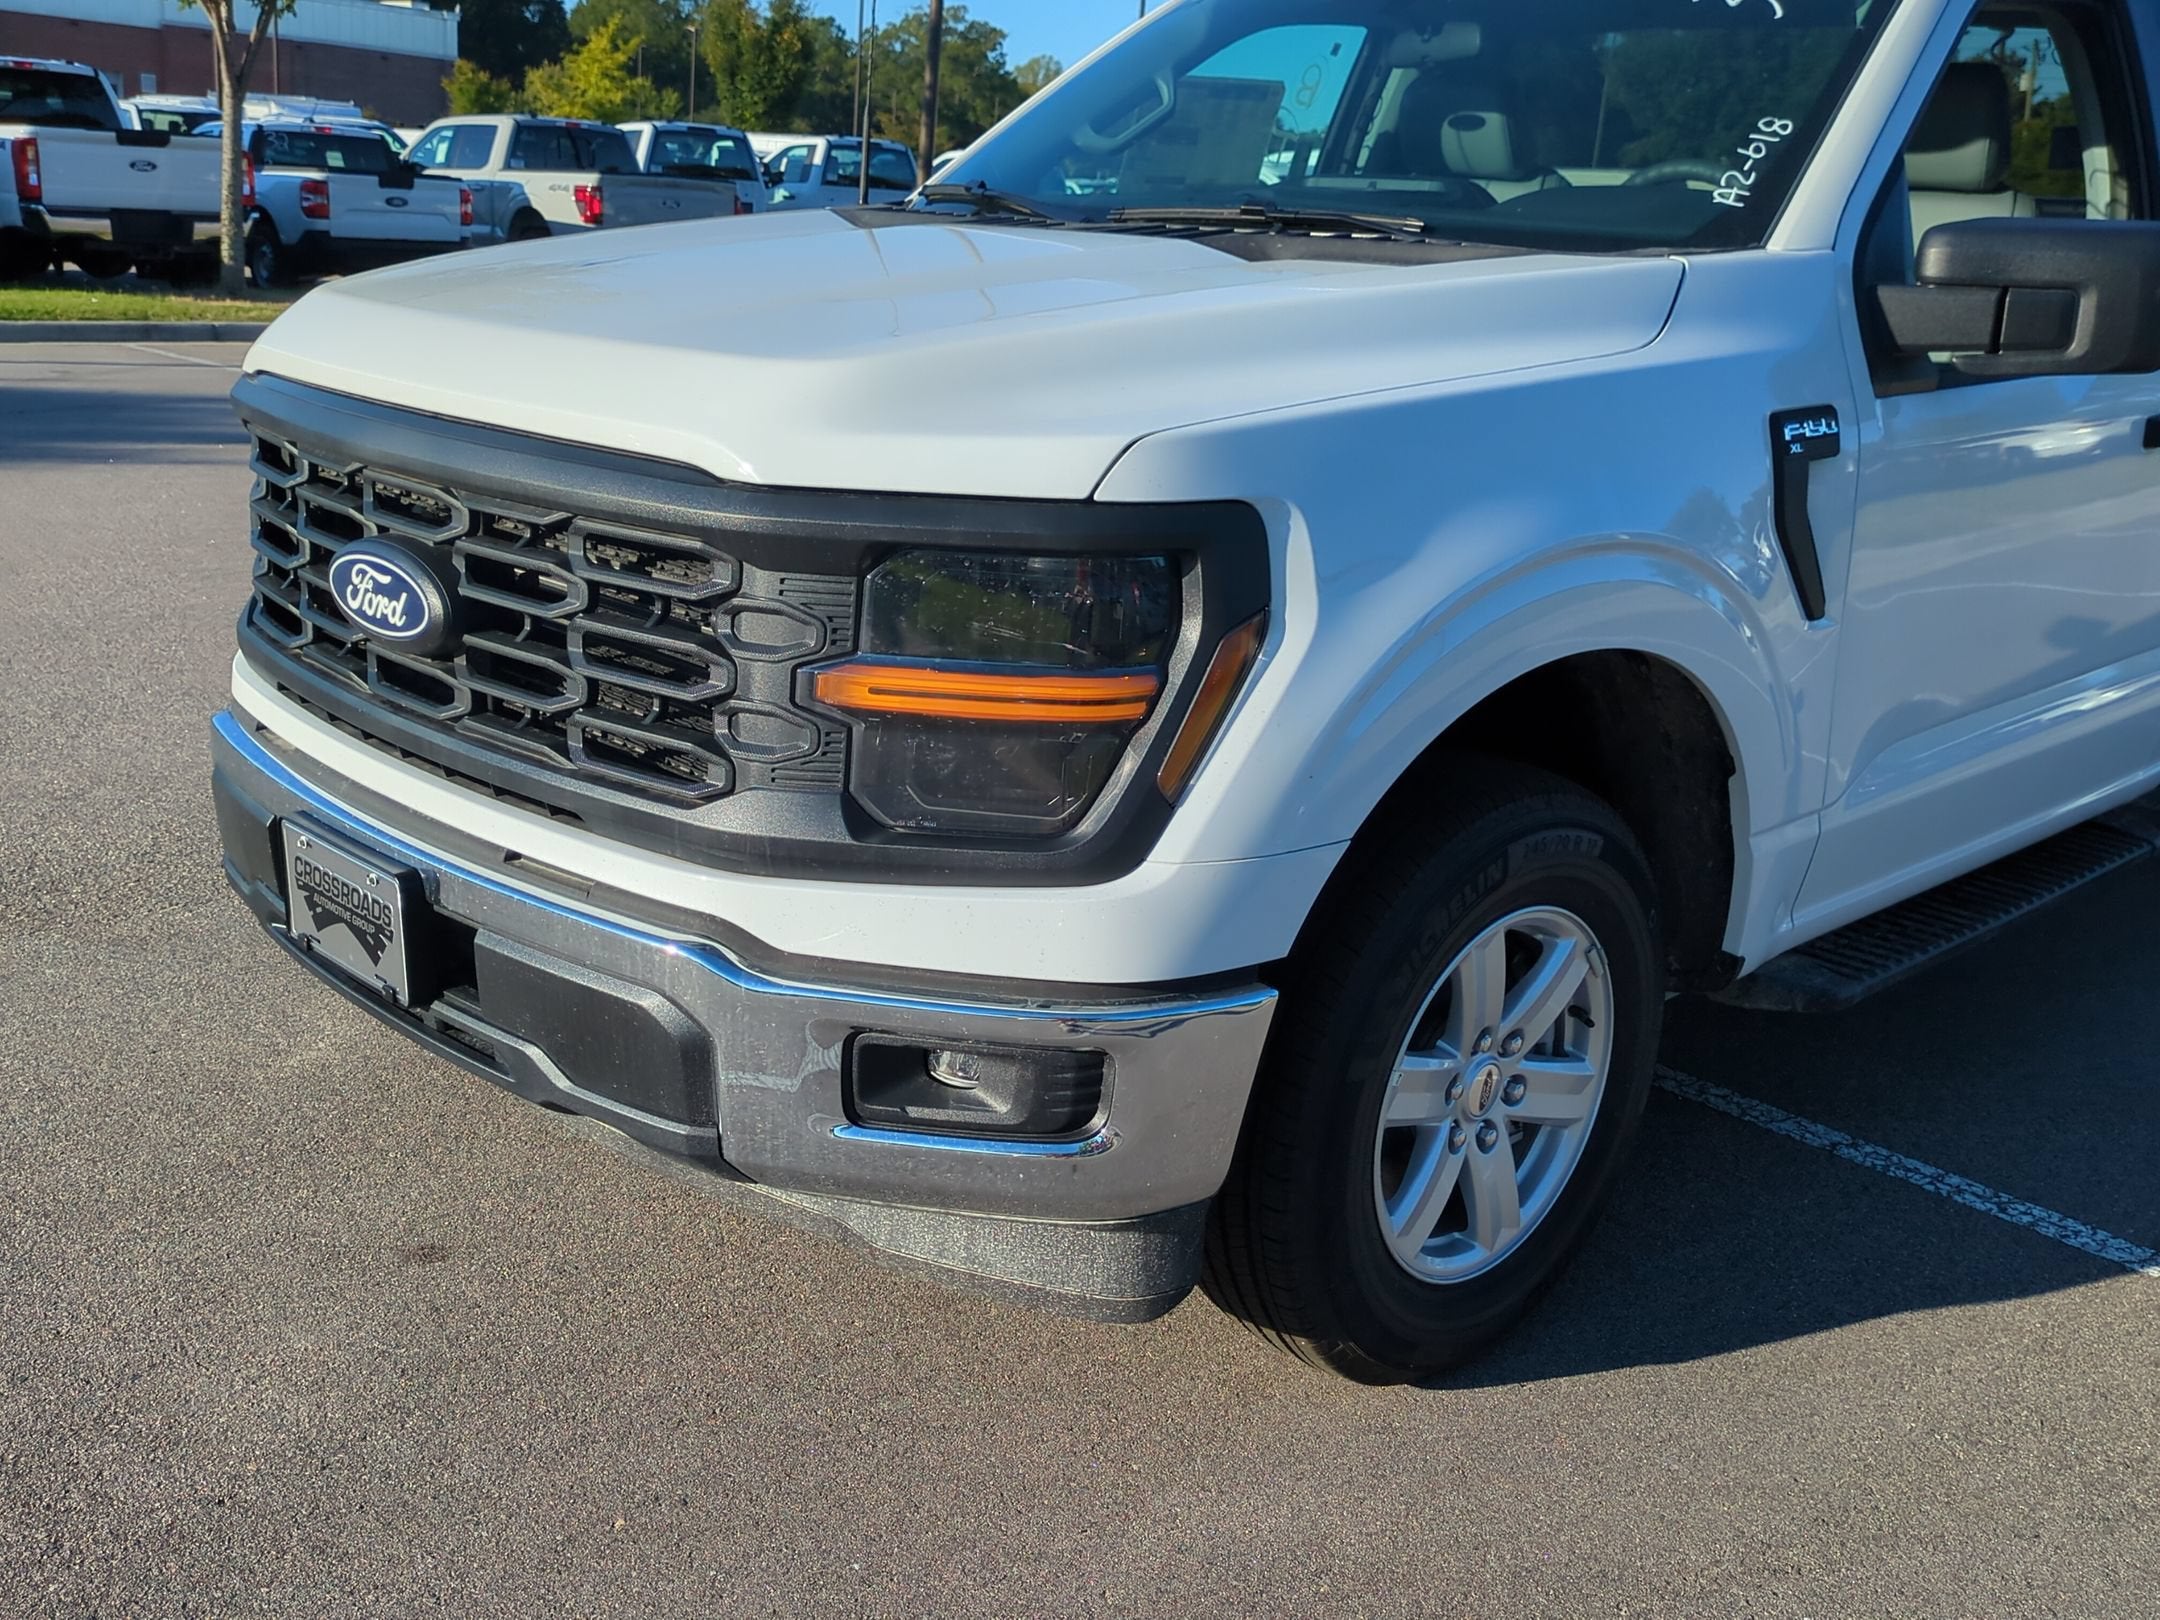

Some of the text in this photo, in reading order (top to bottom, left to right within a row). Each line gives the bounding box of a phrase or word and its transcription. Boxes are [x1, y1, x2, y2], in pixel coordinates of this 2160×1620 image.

[1712, 117, 1793, 207] A2-618
[1790, 443, 1803, 453] XL
[346, 563, 407, 627] Ford
[294, 855, 393, 930] CROSSROADS
[313, 892, 376, 934] AUTOMOTIVE GROUP
